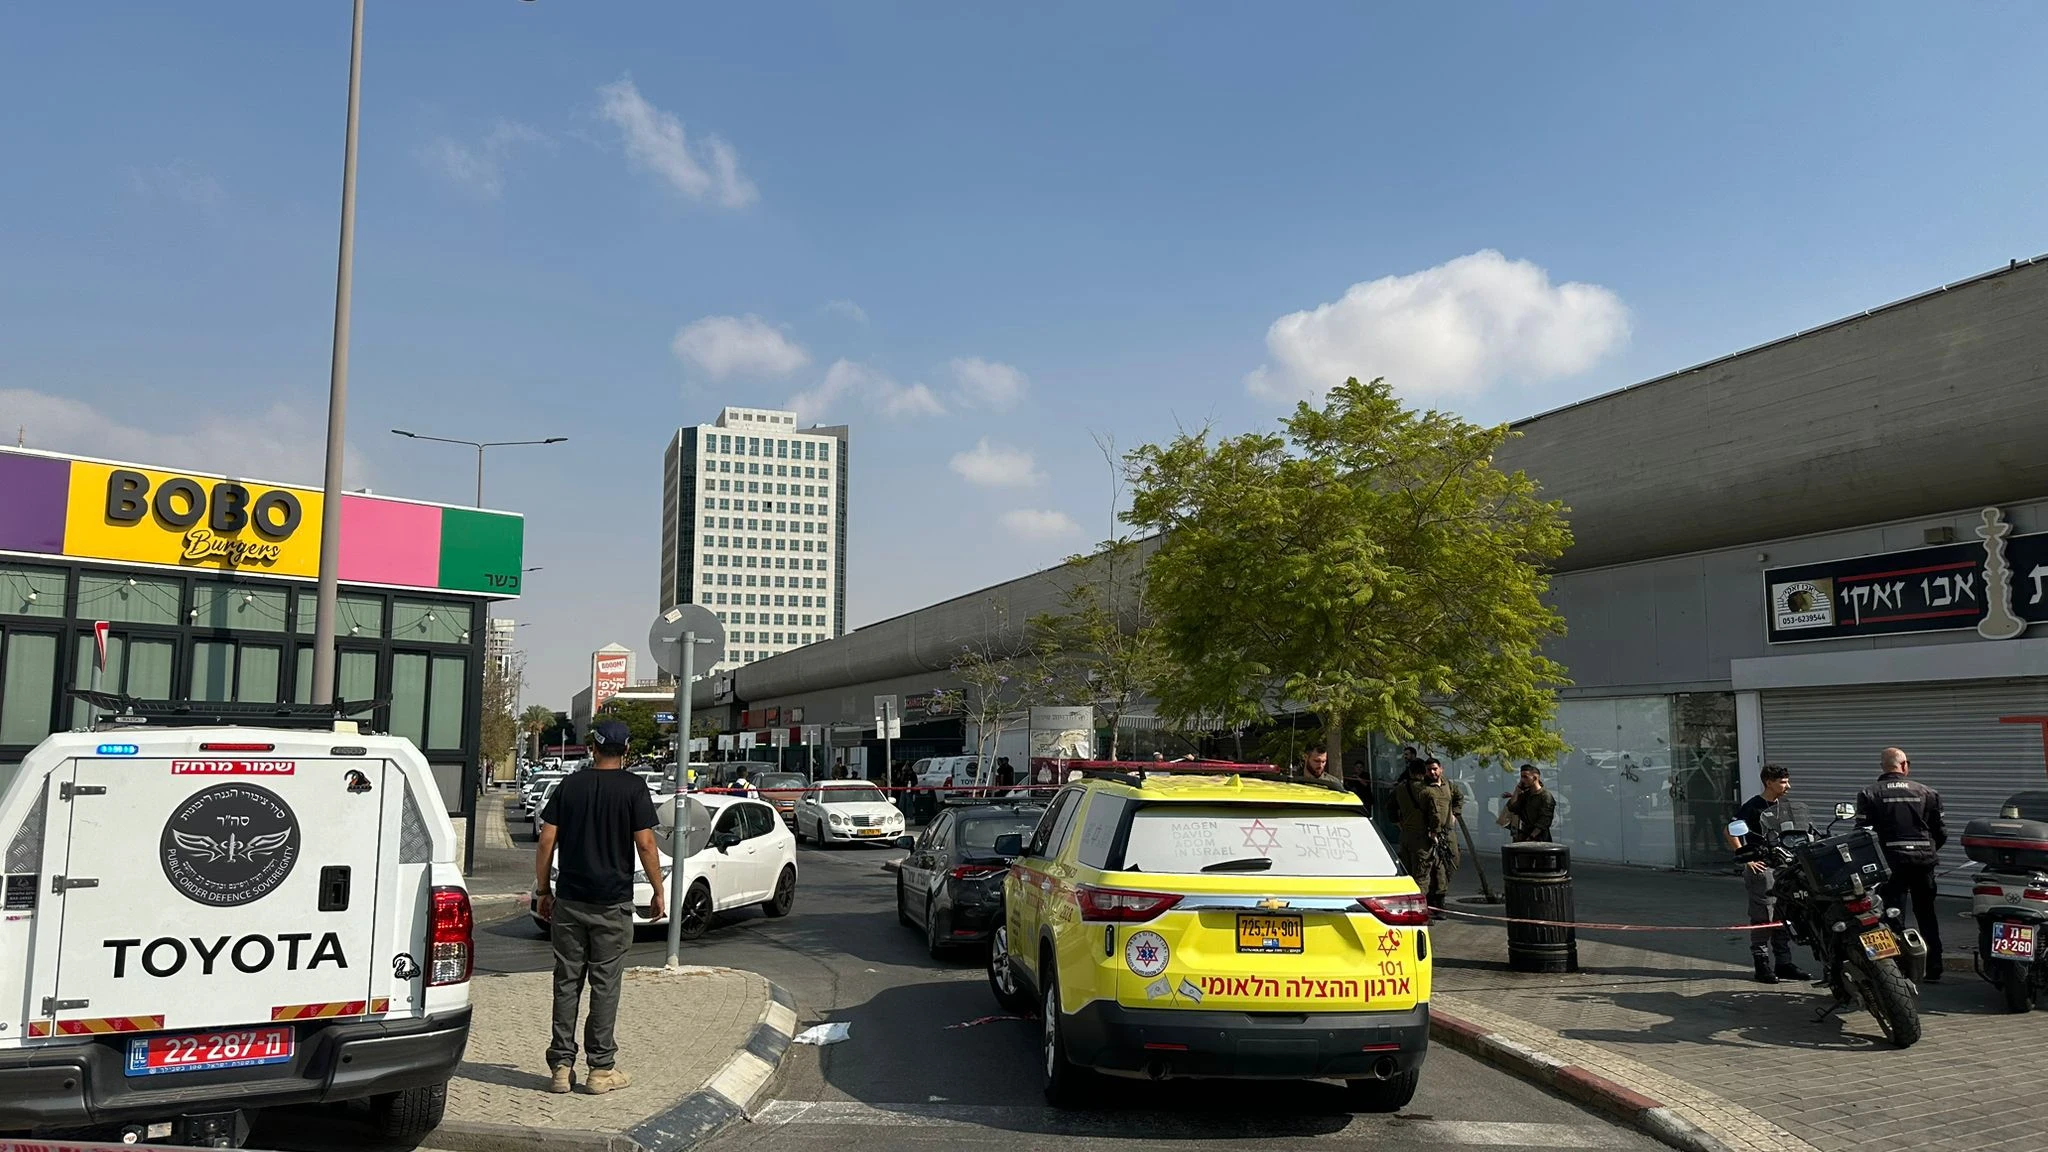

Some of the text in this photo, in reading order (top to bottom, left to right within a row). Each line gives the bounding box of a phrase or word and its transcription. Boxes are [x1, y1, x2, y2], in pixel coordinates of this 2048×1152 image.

[108, 469, 303, 537] BOBO
[187, 529, 281, 563] Burgers
[484, 572, 519, 588] כשר
[1840, 571, 1976, 626] אבו זאקי
[1782, 613, 1826, 625] 053-6239544
[174, 760, 293, 774] שמור מרחק
[213, 788, 239, 801] הגנה
[241, 790, 269, 806] ציבורי
[270, 801, 286, 819] סדר
[1171, 821, 1218, 832] MAGEN
[1294, 822, 1320, 835] דוד
[1172, 829, 1213, 840] DAVID
[1174, 838, 1216, 849] ADOM
[1312, 835, 1355, 850] אדום
[1174, 846, 1236, 857] IN ISRAEL
[167, 845, 295, 902] PUBLIC ORDER DEFENCE SOVEREIGNTY
[2009, 927, 2020, 939] מ
[102, 932, 349, 979] TOYOTA
[1376, 960, 1404, 977] 101
[1200, 974, 1411, 1003] ארגון ההצלה הלאומי
